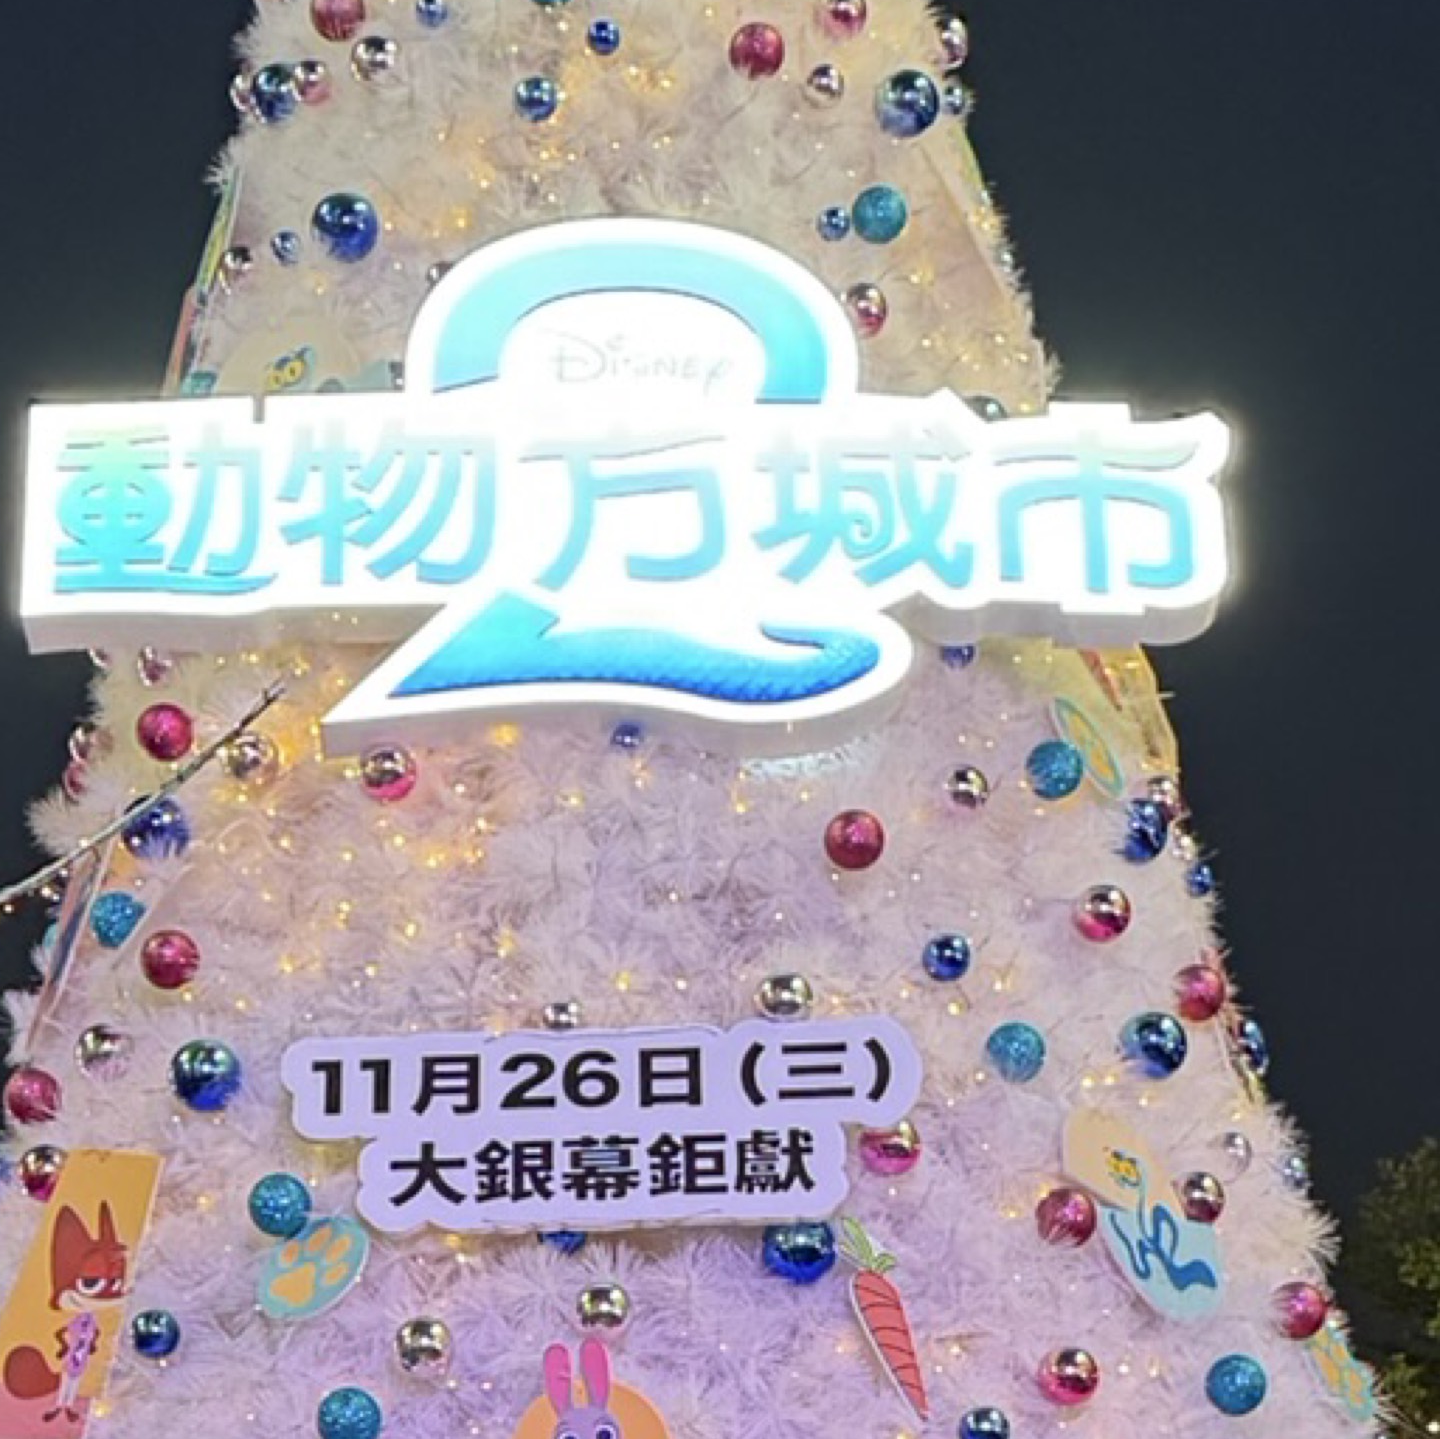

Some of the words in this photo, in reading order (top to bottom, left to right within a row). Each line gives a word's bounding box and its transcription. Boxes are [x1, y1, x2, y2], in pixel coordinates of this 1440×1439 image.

[54, 422, 1200, 596] 動物方城市
[389, 1129, 816, 1208] 大銀幕鉅獻
